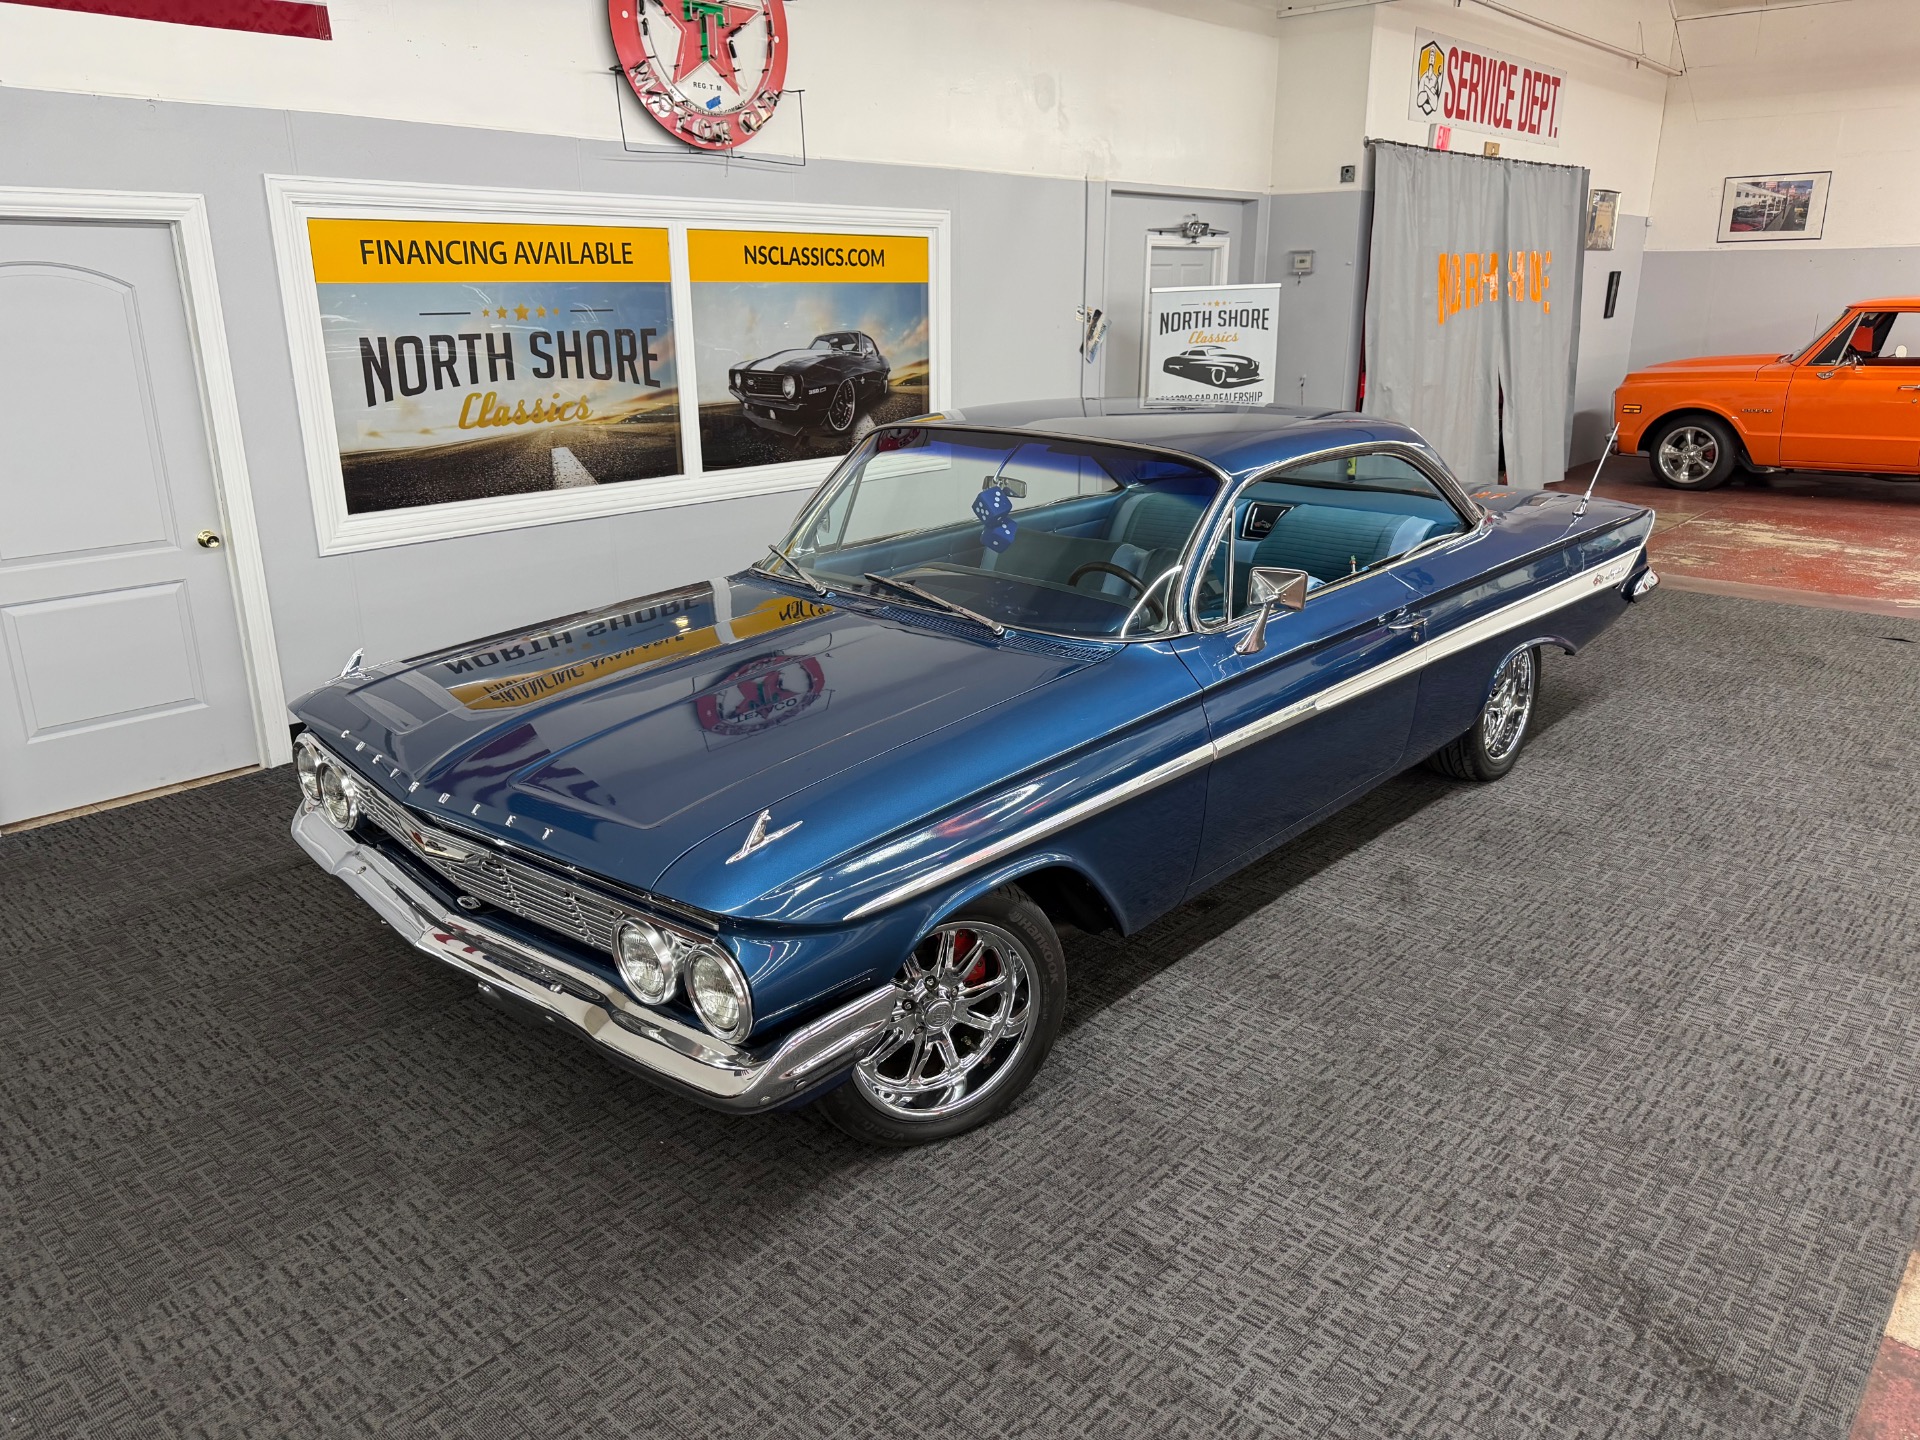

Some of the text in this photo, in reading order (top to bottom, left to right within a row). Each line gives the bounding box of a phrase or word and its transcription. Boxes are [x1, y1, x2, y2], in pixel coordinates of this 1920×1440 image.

[1443, 46, 1561, 138] SERVICE DEPT.
[360, 239, 634, 265] FINANCING AVAILABLE
[744, 245, 885, 267] NSCLASSICS.COM
[1159, 308, 1270, 336] NORTH SHORE
[1188, 331, 1239, 344] Classics
[358, 327, 661, 407] NORTH SHORE
[458, 390, 594, 430] Classics
